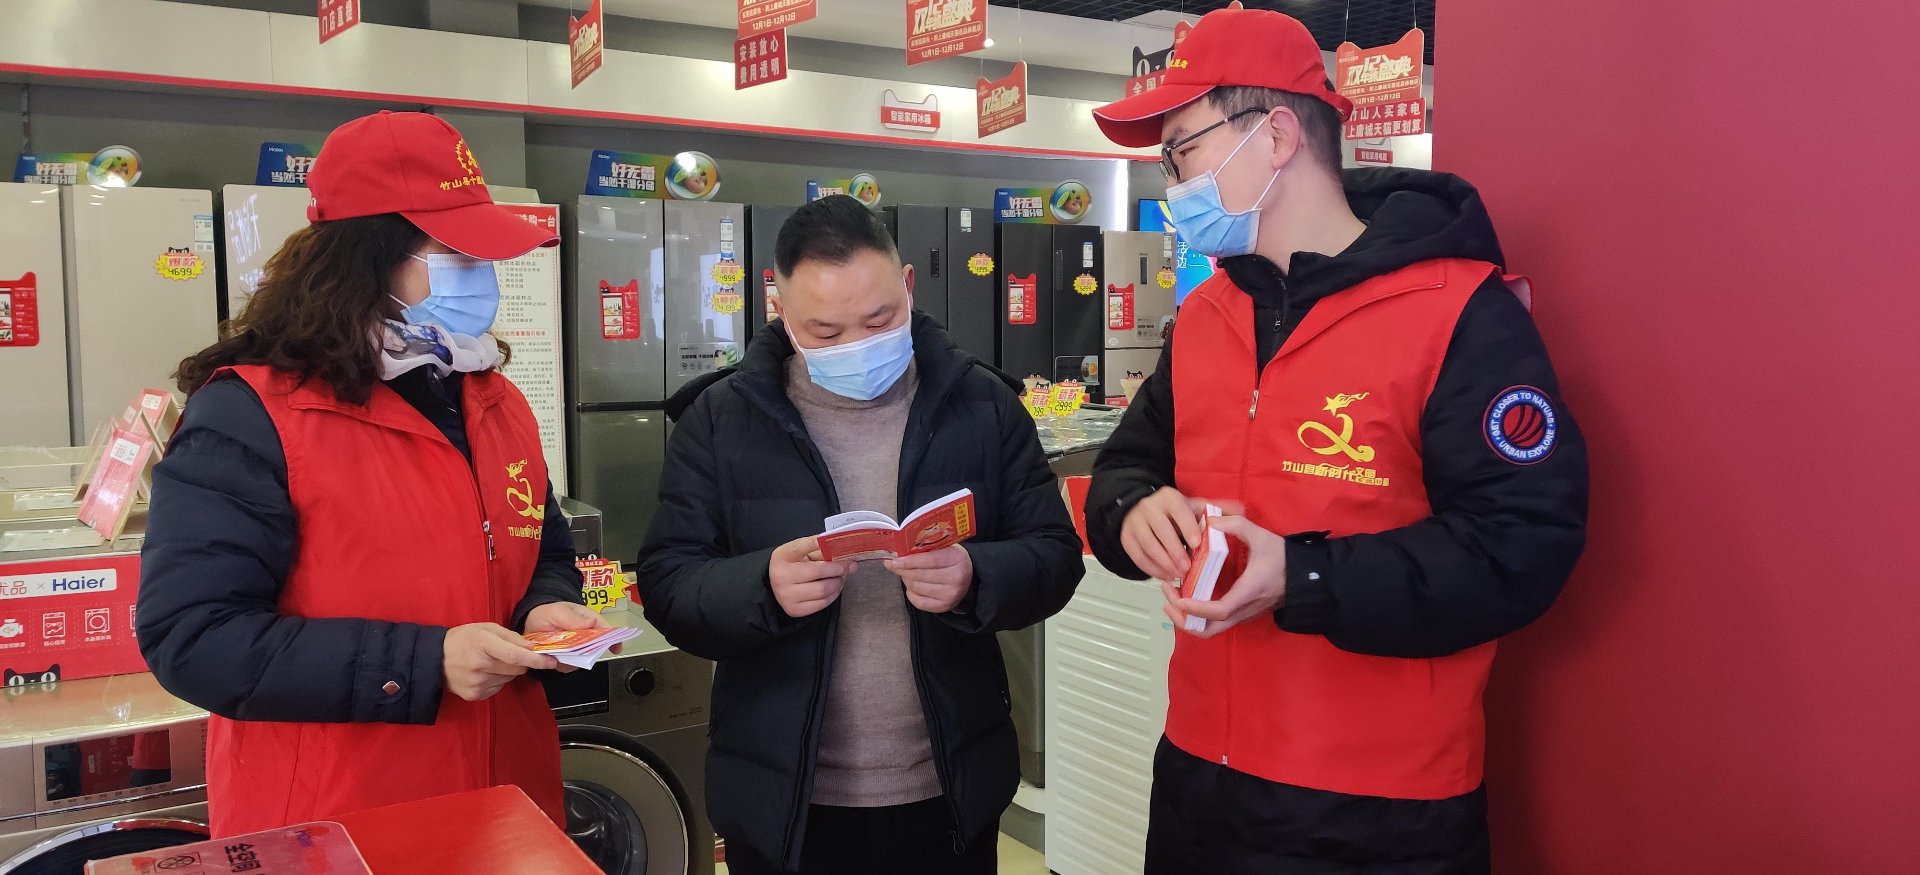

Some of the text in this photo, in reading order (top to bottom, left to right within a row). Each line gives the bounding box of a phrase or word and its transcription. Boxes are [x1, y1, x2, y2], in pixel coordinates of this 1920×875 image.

[740, 35, 778, 62] 安装放心
[740, 57, 780, 84] 费用透明
[168, 267, 193, 276] 4699
[1493, 393, 1520, 418] CLOSER
[1520, 392, 1532, 400] TO
[1531, 394, 1555, 425] NATURE
[1499, 428, 1555, 459] URBAN EXPLORE
[52, 575, 105, 592] Haier
